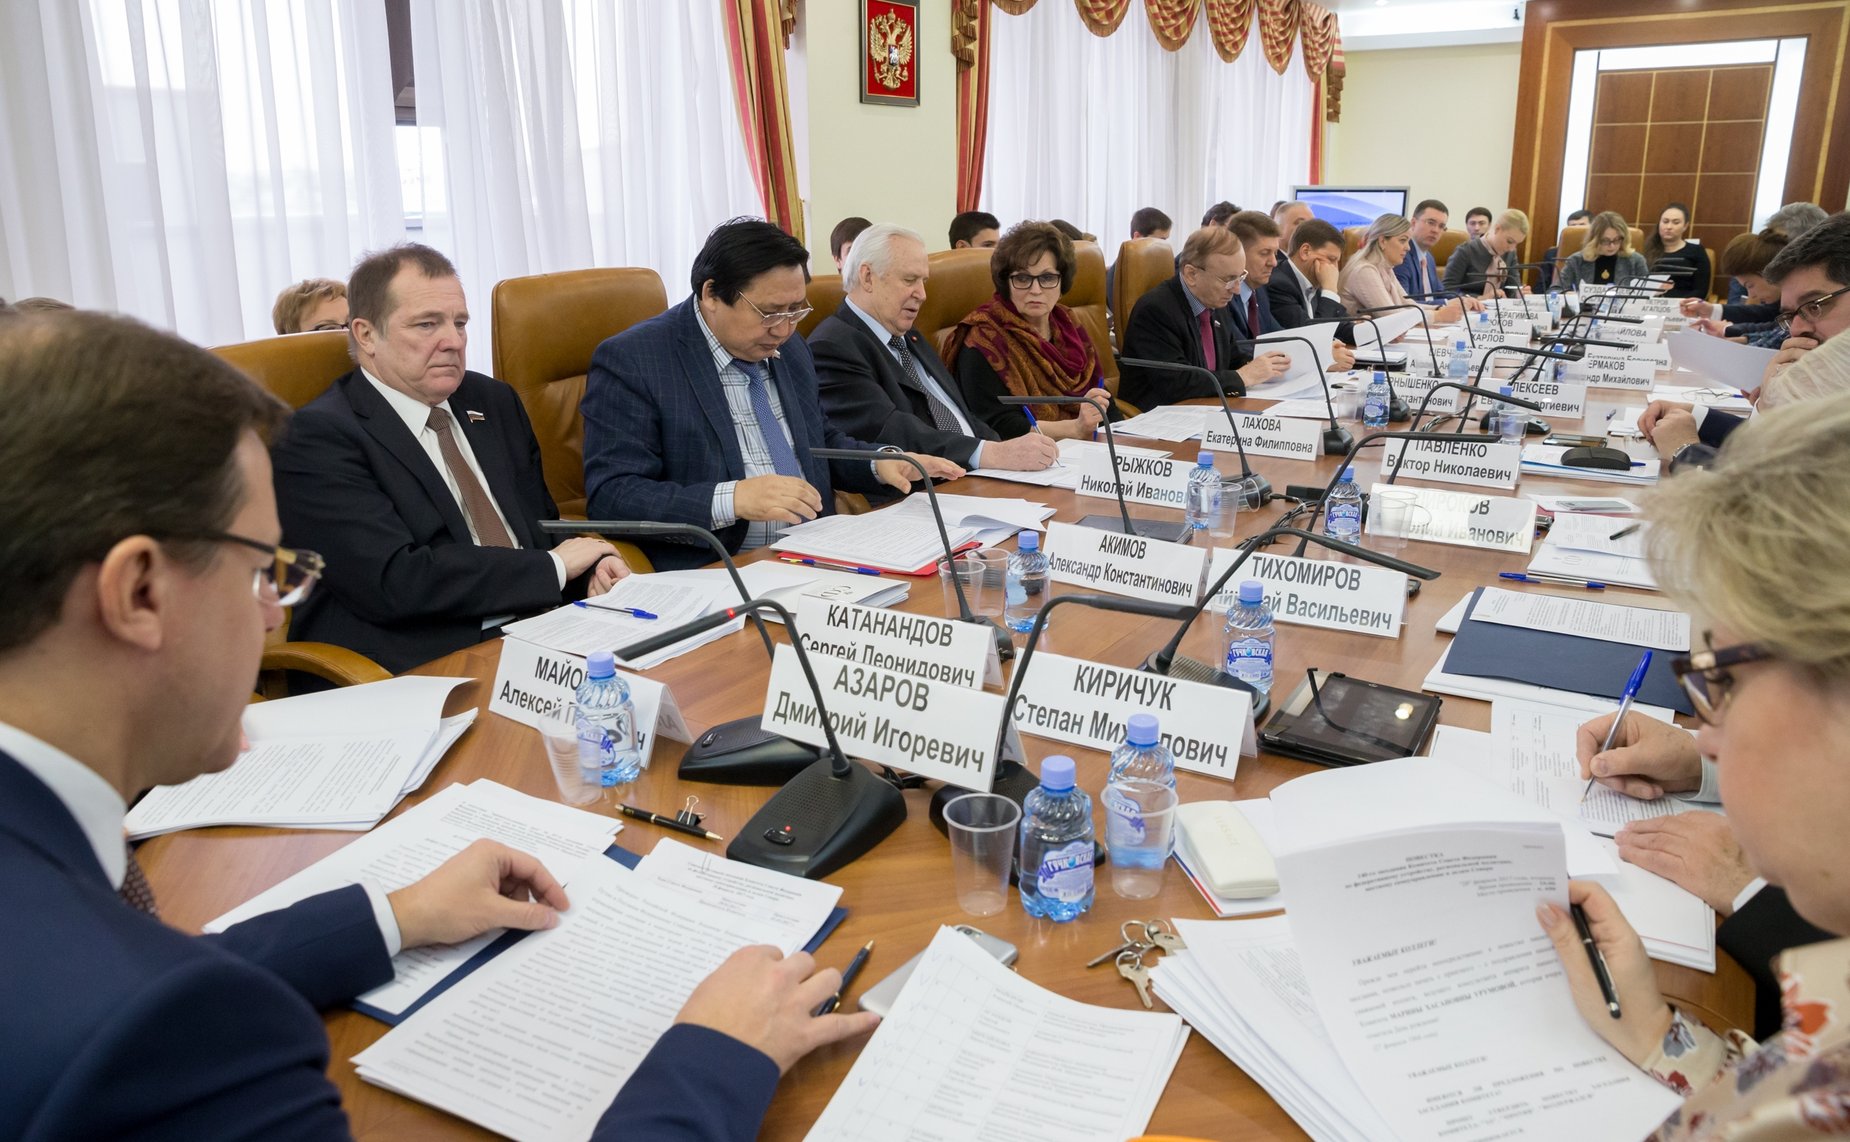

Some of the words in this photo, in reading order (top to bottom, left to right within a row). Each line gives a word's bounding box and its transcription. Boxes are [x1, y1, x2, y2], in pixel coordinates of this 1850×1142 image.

[1494, 311, 1539, 321] ИБРАГИМВА
[1510, 381, 1559, 395] ЛЕКСЕЕВ
[1602, 373, 1650, 386] Михайлович
[1241, 416, 1282, 432] ЛАХОВА
[1254, 435, 1313, 453] Филипповна
[1415, 440, 1488, 458] ПАВЛЕНКО
[1115, 455, 1173, 478] РЫЖКОВ
[1386, 454, 1430, 475] Вктор
[1433, 459, 1512, 481] Николаевич
[1081, 474, 1133, 497] Николай
[1136, 482, 1187, 504] Иванов
[1098, 534, 1147, 560] АКИМОВ
[1048, 552, 1101, 583] Александр
[1103, 562, 1193, 598] Константинович
[1252, 556, 1361, 591] ТИХОМИРОВ
[826, 604, 954, 648] КАТАНАНДОВ
[1286, 593, 1392, 630] Васильевич
[534, 656, 590, 691] МАЙО
[800, 632, 857, 663] Сергей
[862, 643, 976, 688] Леонидович
[500, 680, 563, 721] Алексей
[833, 664, 930, 712] АЗАРОВ
[1073, 664, 1177, 711] КИРИЧУК
[872, 716, 985, 773] Игоревич
[1012, 694, 1084, 735] Степан
[1089, 710, 1229, 768] Михлович
